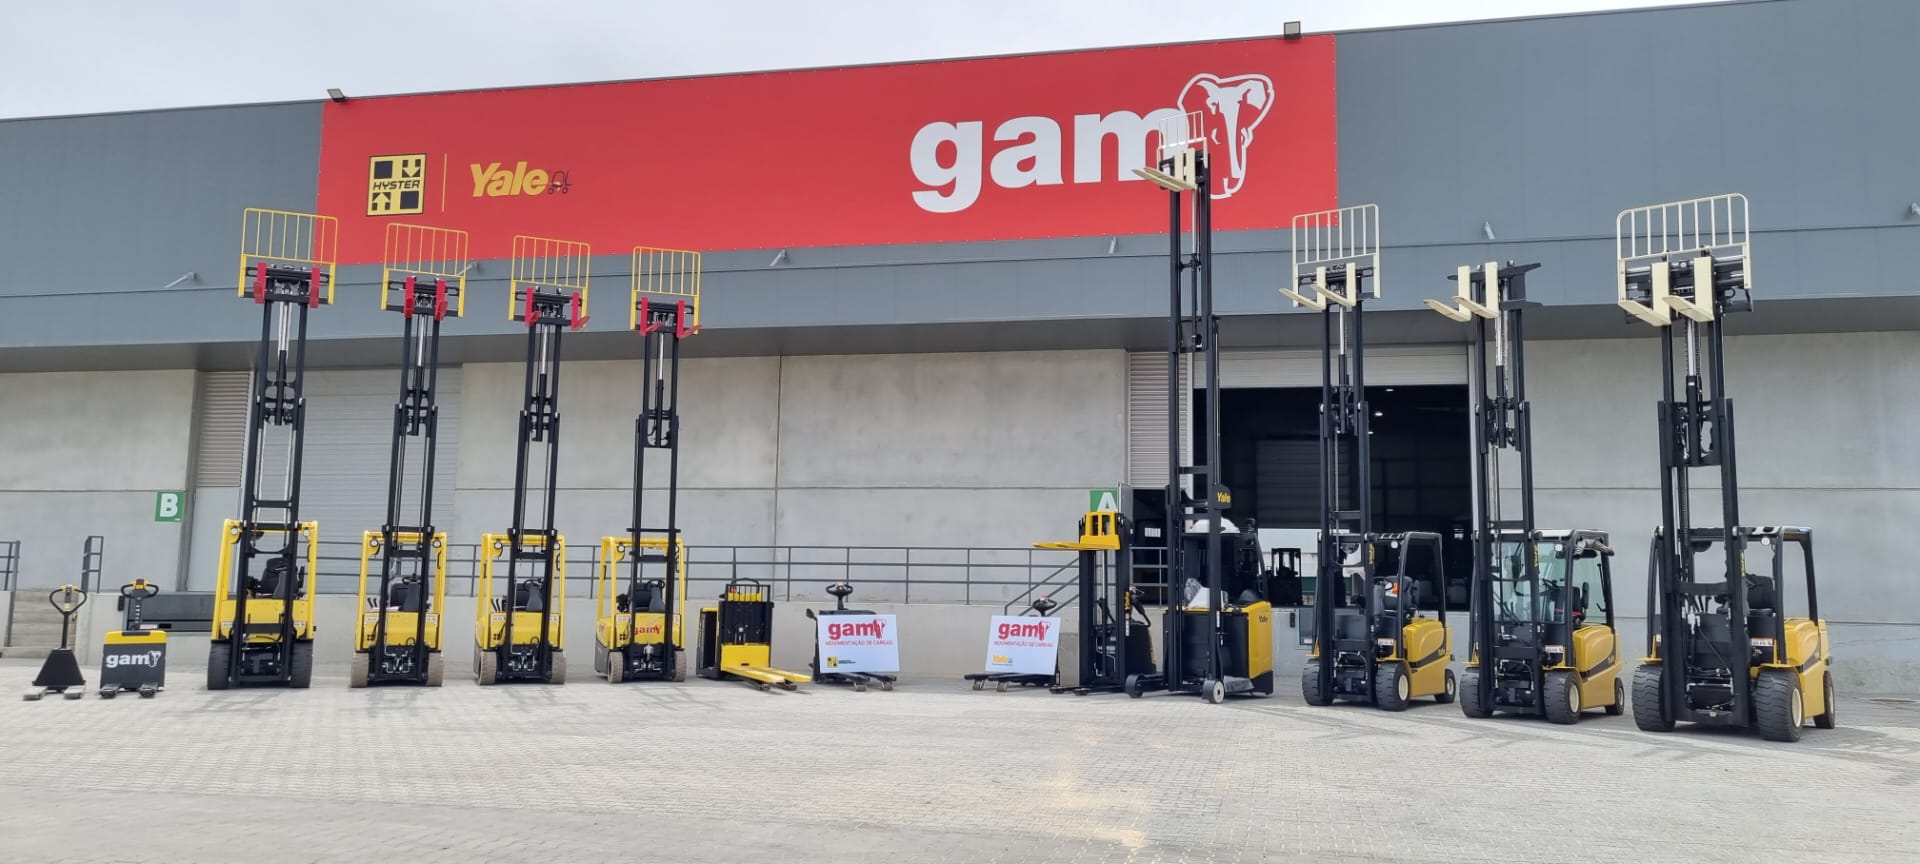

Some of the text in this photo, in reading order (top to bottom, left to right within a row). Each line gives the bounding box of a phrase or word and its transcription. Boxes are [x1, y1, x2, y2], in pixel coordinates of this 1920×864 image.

[910, 108, 1191, 213] gam
[373, 180, 420, 191] HYSTER
[470, 161, 549, 197] Yale
[160, 493, 178, 517] B
[1096, 491, 1118, 512] A
[1216, 492, 1231, 503] Yale
[828, 623, 873, 640] gam
[998, 623, 1039, 640] gam
[106, 654, 150, 668] gam
